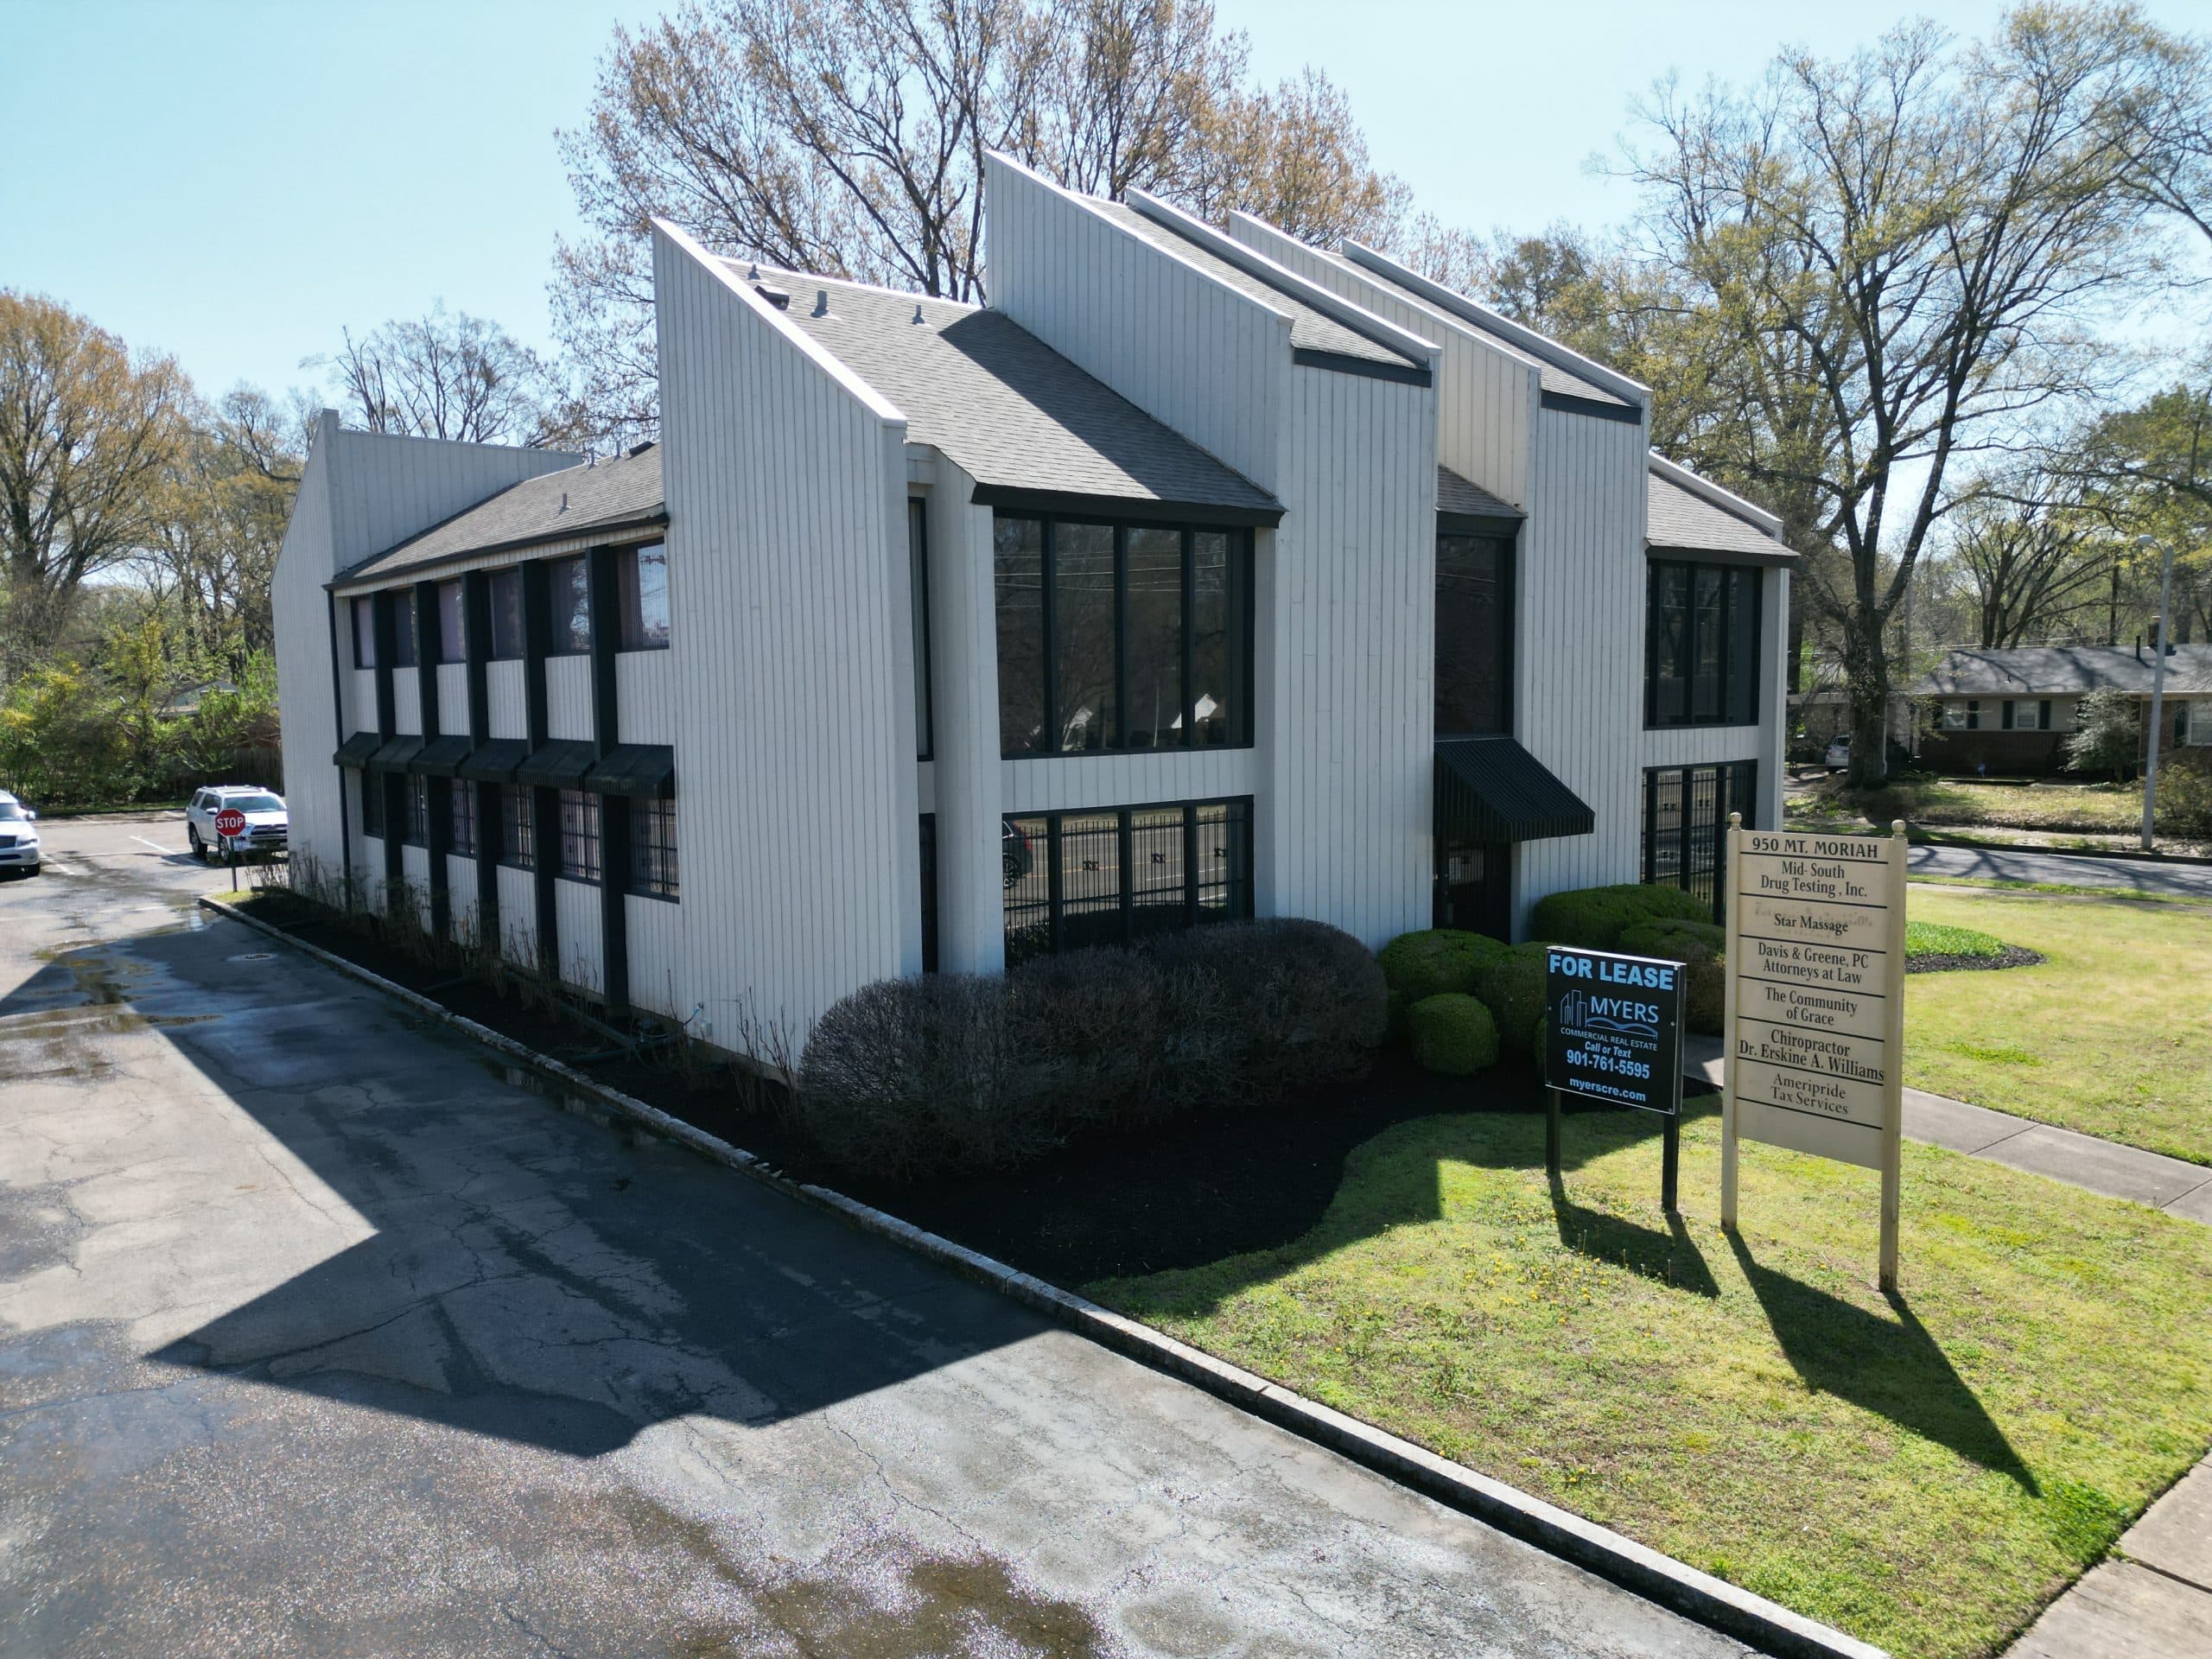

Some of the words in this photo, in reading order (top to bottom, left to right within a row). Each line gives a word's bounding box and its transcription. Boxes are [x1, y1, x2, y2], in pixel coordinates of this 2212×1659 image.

[217, 817, 244, 829] STOP
[1752, 837, 1778, 851] 950
[1784, 840, 1808, 853] MT.
[1815, 842, 1878, 858] MORIAH
[1761, 875, 1789, 893] Drug
[1846, 882, 1867, 897] Inc.
[1774, 913, 1796, 927] Star
[1801, 916, 1848, 935] Massage
[1758, 943, 1788, 958] Davis
[1792, 948, 1801, 959] &
[1804, 948, 1848, 967] Greene,
[1853, 954, 1868, 968] PC
[1549, 954, 1592, 978] FOR
[1599, 962, 1674, 990] LEASE
[1763, 959, 1819, 982] Attorneys
[1822, 969, 1834, 980] at
[1838, 968, 1861, 984] Law
[1591, 996, 1659, 1023] MYERS
[1765, 987, 1786, 1001] The
[1789, 990, 1858, 1017] Community
[1786, 1007, 1798, 1019] of
[1801, 1008, 1834, 1026] Grace
[1560, 1027, 1608, 1042] COMMERCIAL
[1611, 1036, 1630, 1046] REAL
[1630, 1039, 1658, 1051] ESTATE
[1585, 1041, 1600, 1052] Call
[1603, 1046, 1611, 1054] or
[1613, 1046, 1631, 1058] Text
[1771, 1029, 1850, 1057] Chiropractor
[1567, 1050, 1649, 1078] 901-761-5595
[1740, 1039, 1757, 1055] Dr.
[1761, 1044, 1807, 1065] Erskine
[1811, 1054, 1823, 1069] A.
[1828, 1057, 1885, 1080] Williams
[1570, 1078, 1646, 1102] myerscre.com
[1774, 1073, 1846, 1099] Ameripride
[1770, 1086, 1793, 1102] Tax
[1796, 1093, 1848, 1114] Services
